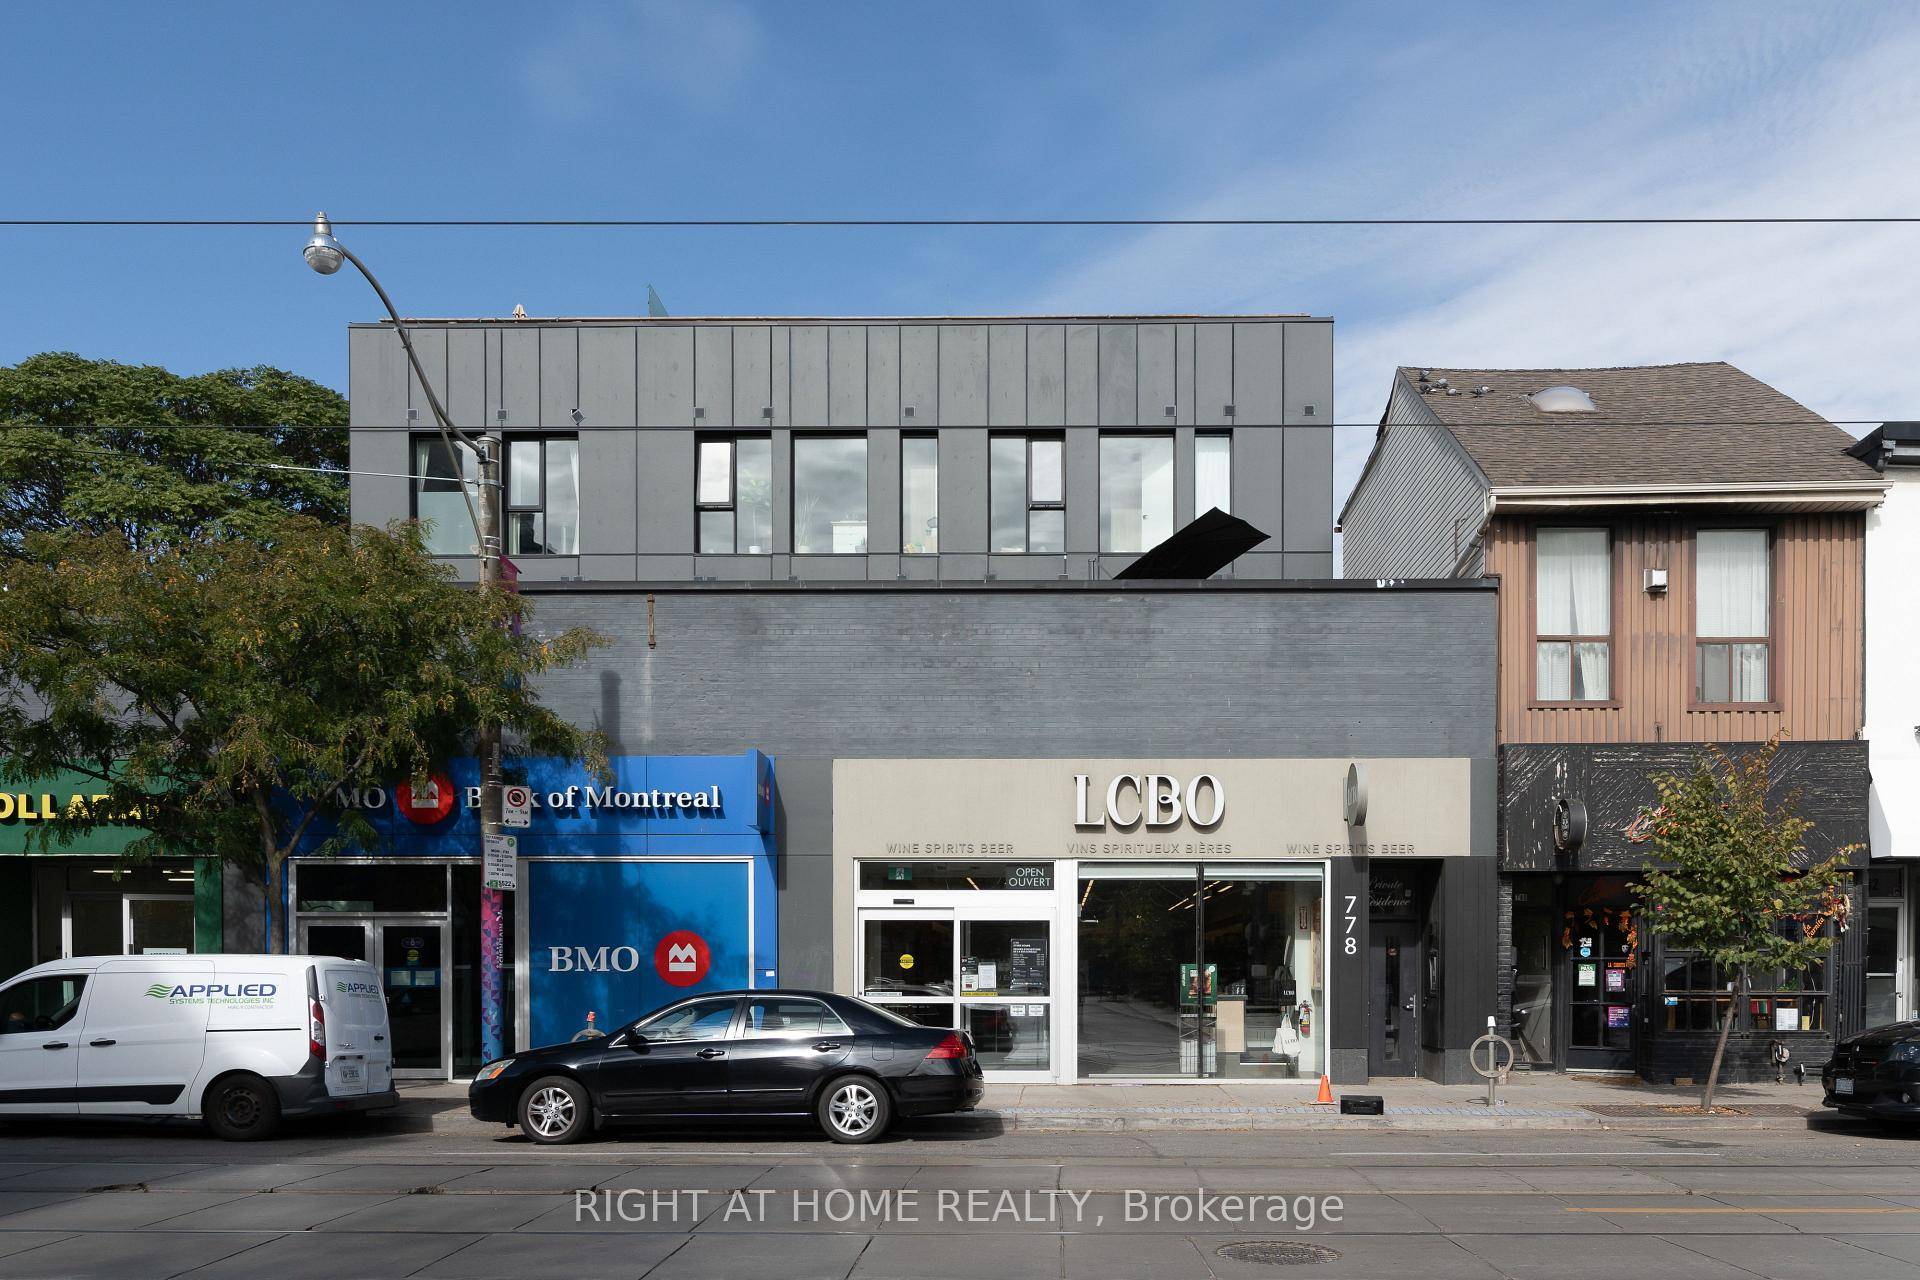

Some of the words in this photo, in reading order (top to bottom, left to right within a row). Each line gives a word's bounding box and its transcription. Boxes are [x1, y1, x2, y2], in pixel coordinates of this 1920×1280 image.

[464, 786, 542, 808] Bk
[547, 786, 579, 808] of
[584, 785, 722, 809] Montreal
[1074, 774, 1225, 826] LCBO
[886, 843, 920, 854] WINE
[925, 843, 975, 854] SPIRITS
[980, 843, 1015, 854] BEER
[1066, 843, 1097, 854] VINS
[1103, 843, 1180, 854] SPIRITUEUX
[1185, 841, 1232, 854] BIÈRES
[1286, 844, 1320, 854] WINE
[1326, 844, 1375, 854] SPIRITS
[1381, 844, 1415, 854] BEER
[1016, 867, 1044, 877] OPEN
[1008, 877, 1051, 887] OUVERT
[1344, 895, 1357, 955] 778
[548, 945, 640, 973] BMO
[169, 984, 277, 998] APPLIED
[347, 982, 380, 995] APPLIED
[207, 997, 261, 1005] TECHNOLOGIES
